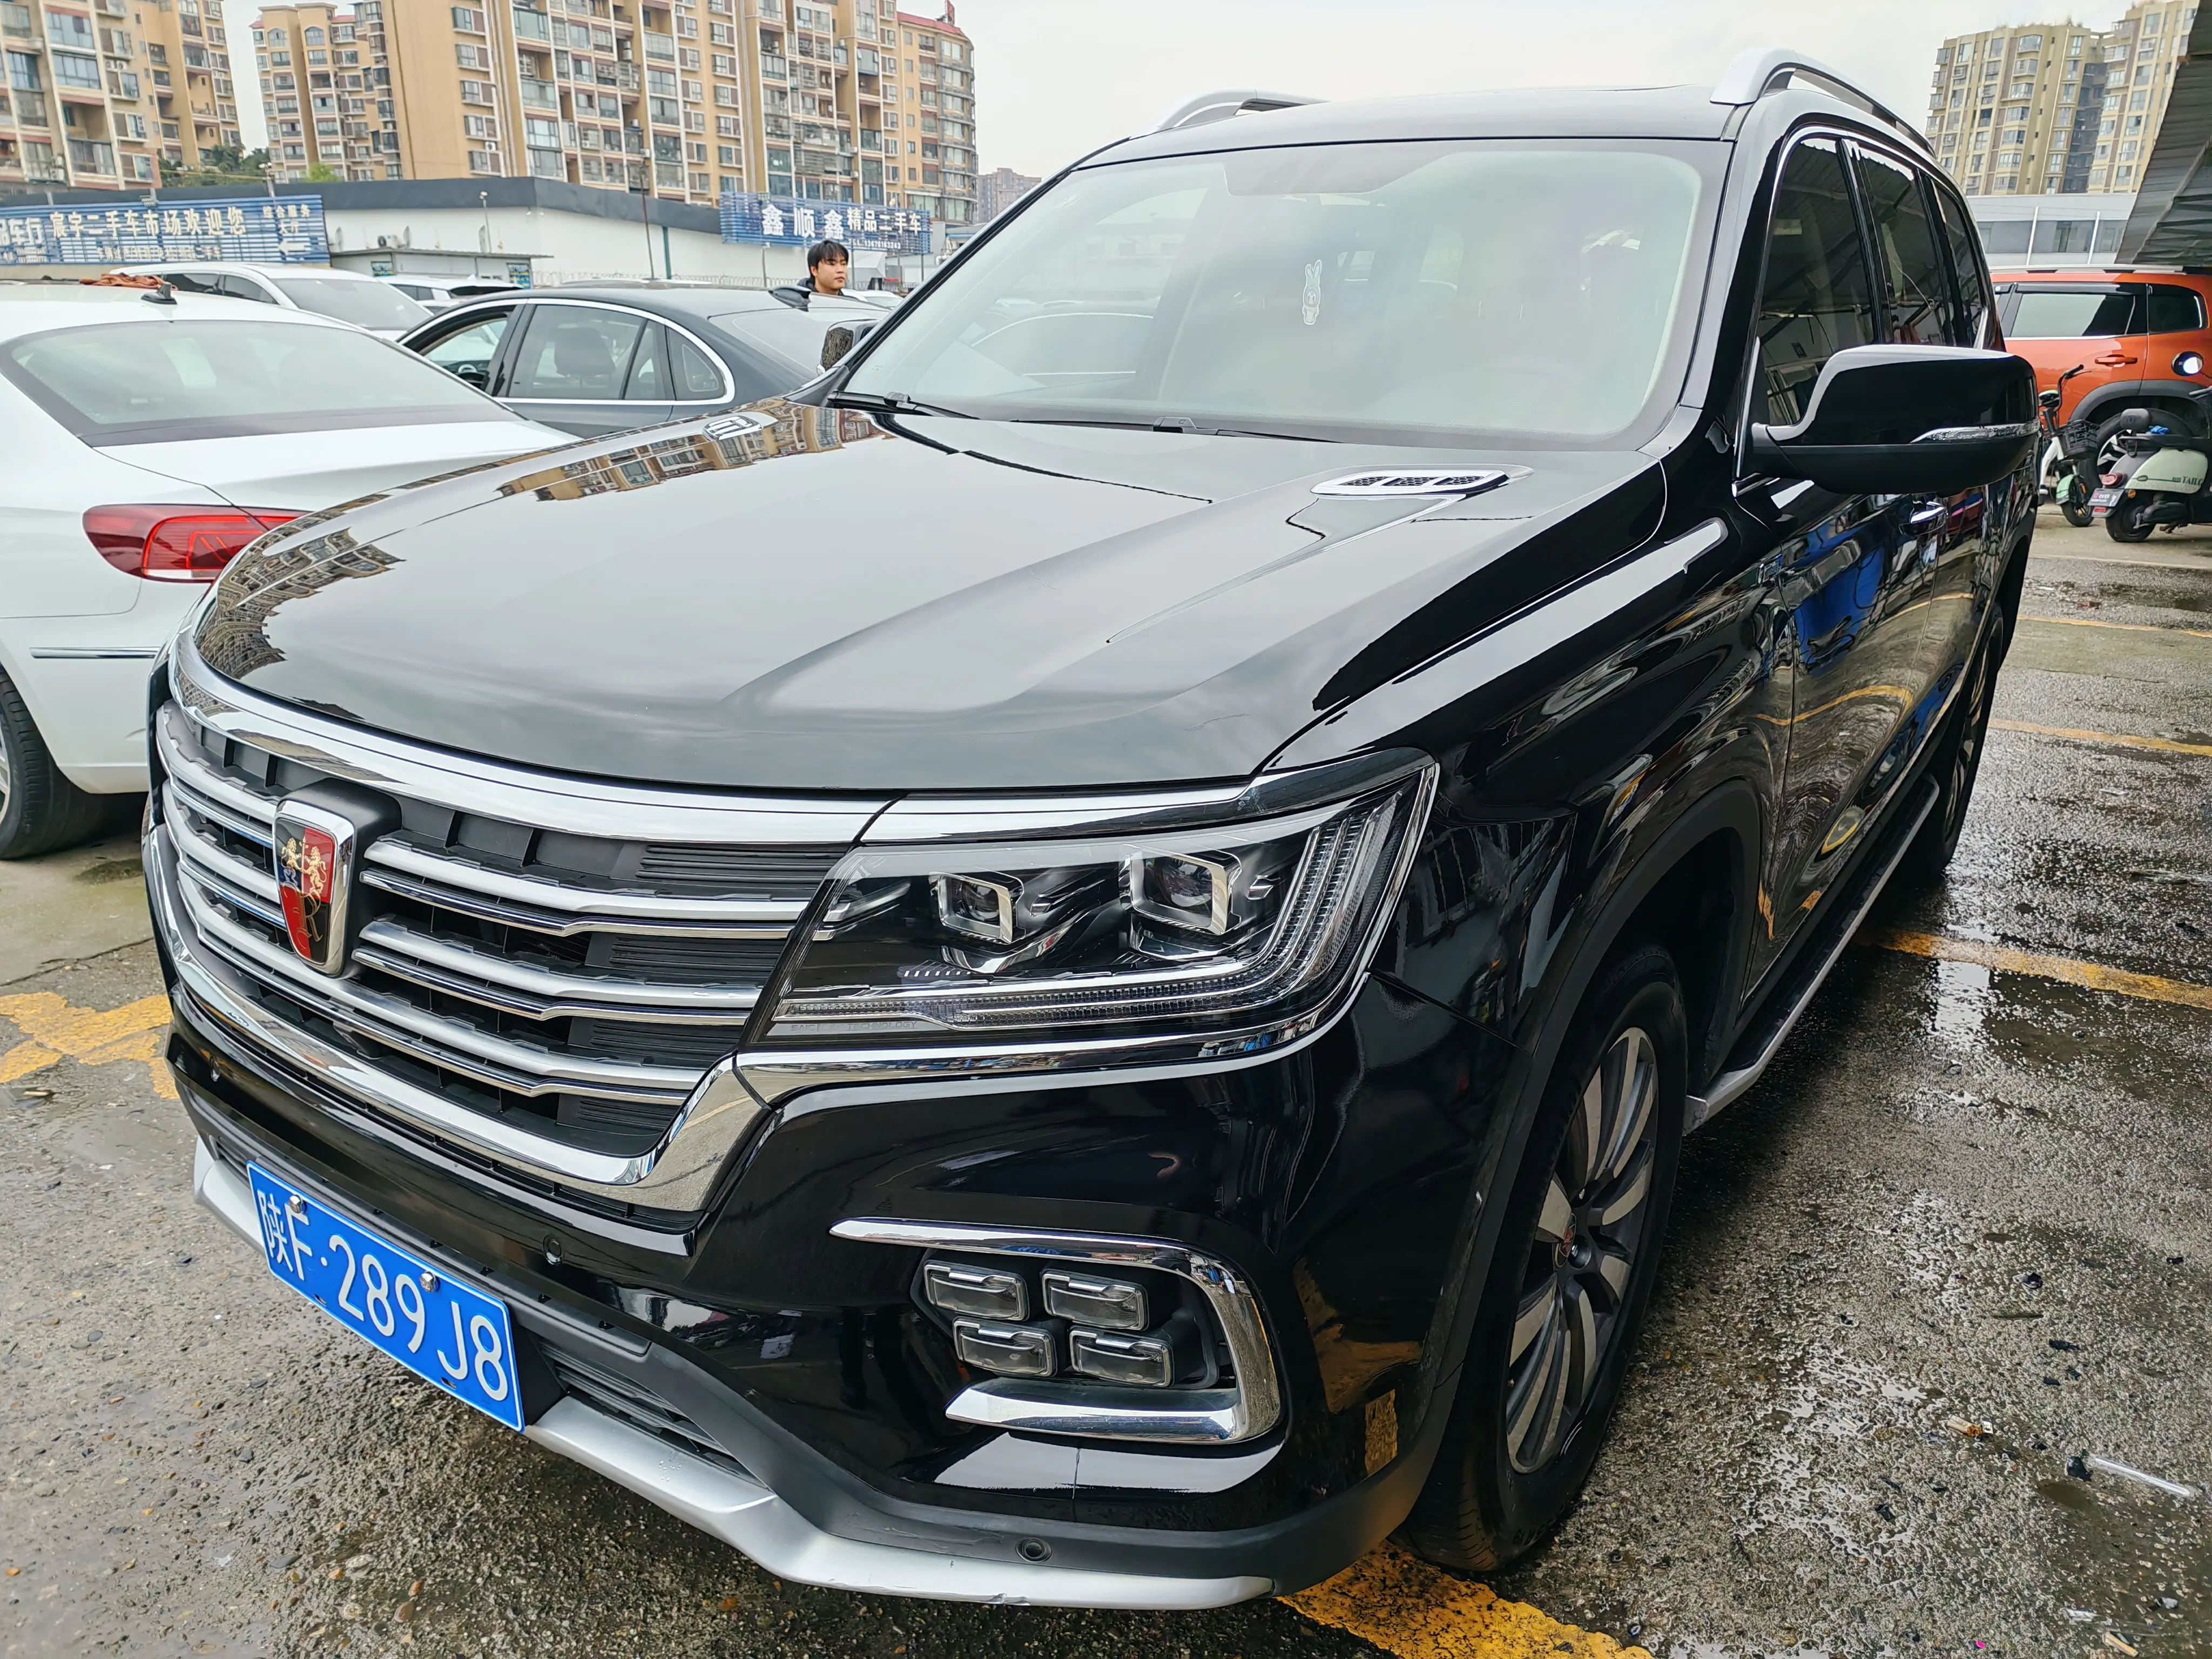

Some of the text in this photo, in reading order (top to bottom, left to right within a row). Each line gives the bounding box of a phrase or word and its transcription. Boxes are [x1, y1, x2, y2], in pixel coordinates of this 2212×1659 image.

[50, 205, 246, 238] 宸宇二手车市场欢迎您
[761, 204, 921, 240] 鑫顺鑫 精品二手车
[847, 1021, 917, 1030] TECHNOLOGY
